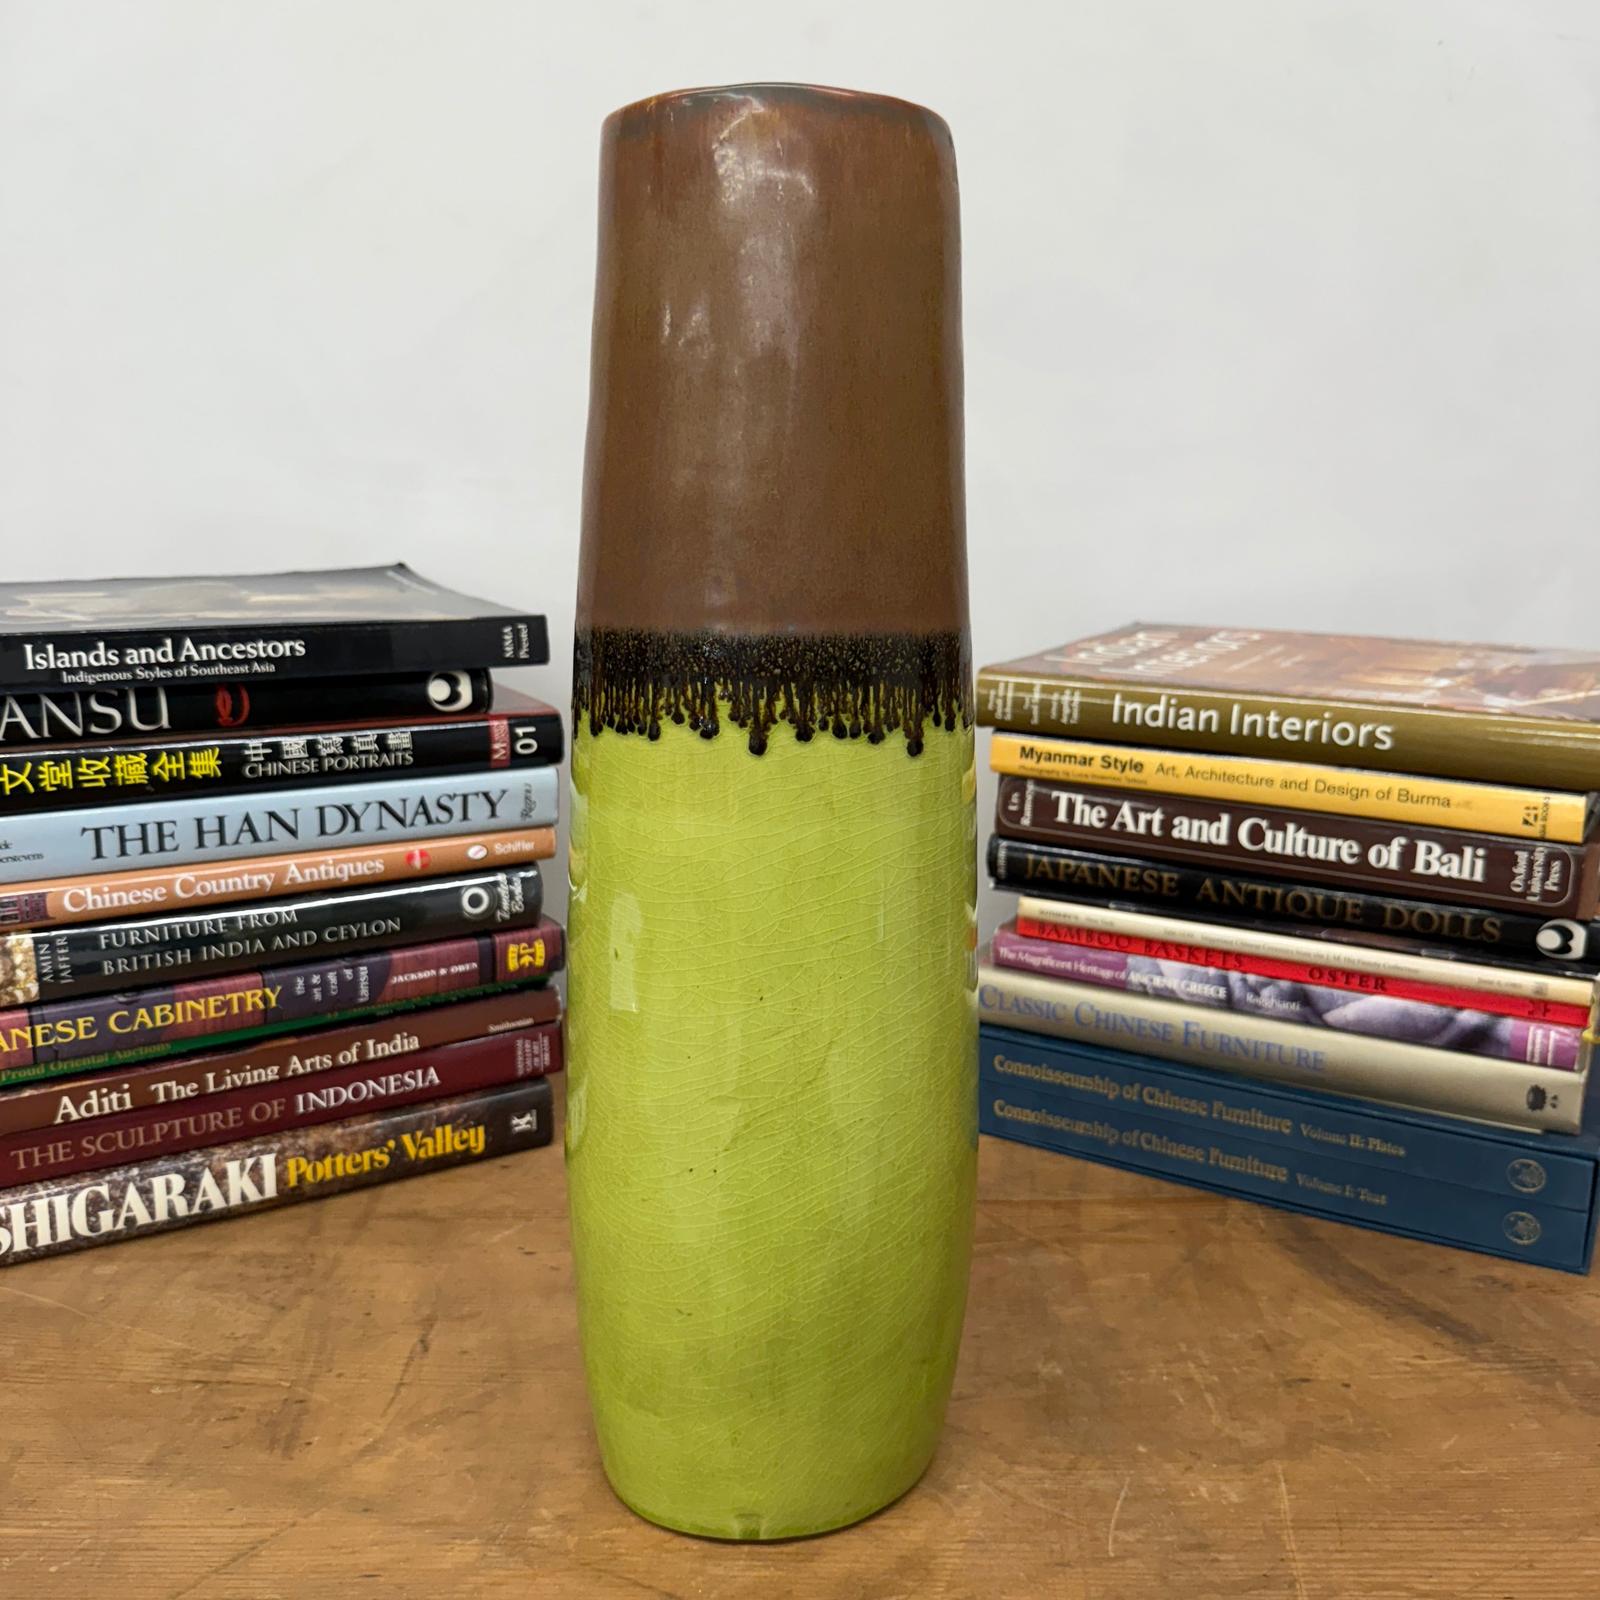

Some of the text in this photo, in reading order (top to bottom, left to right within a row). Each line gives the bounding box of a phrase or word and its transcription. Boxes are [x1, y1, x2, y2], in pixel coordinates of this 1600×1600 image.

[24, 637, 306, 671] Islands and Ancestors
[501, 625, 515, 658] MMA
[516, 623, 530, 659] Prestel
[62, 662, 276, 685] Indigenous Styles of Southeast Asia
[514, 726, 538, 755] 01
[1112, 691, 1220, 734] Indian
[1230, 703, 1395, 751] Interiors
[242, 750, 414, 779] CHINESE PORTRAITS
[1019, 745, 1096, 768] Myanmar
[1100, 754, 1145, 774] Style
[1155, 763, 1178, 779] Art,
[1184, 765, 1275, 788] Architecture
[1279, 776, 1309, 792] and
[1314, 778, 1370, 800] Design
[1375, 782, 1392, 800] of
[1397, 788, 1452, 809] Burma
[81, 789, 508, 861] THE HAN DYNASTY
[1051, 790, 1488, 884] The Art and Culture of Bali
[494, 840, 536, 855] Schiffer
[63, 858, 385, 913] Chinese Country Antiques
[1510, 849, 1529, 893] Oxford
[1527, 846, 1548, 902] University
[1544, 859, 1563, 892] Press
[511, 876, 525, 914] Books
[1023, 852, 1181, 898] JAPANESE
[1198, 878, 1363, 922] ANTIQUE
[1383, 903, 1500, 943] DOLLS
[99, 909, 298, 950] FURNITURE FROM
[103, 917, 401, 977] BRITISH INDIA AND CEYLON
[38, 943, 55, 982] AMIN
[55, 936, 75, 985] JAFFER
[343, 968, 354, 981] of
[392, 969, 437, 984] JACKSON
[998, 946, 1018, 961] The
[1019, 950, 1073, 973] Magnificent
[1073, 959, 1114, 981] Heritage
[1115, 969, 1126, 980] of
[1127, 971, 1184, 992] ANCIENT
[1184, 978, 1229, 1001] GREECE
[1037, 922, 1130, 949] BAMBOO
[1142, 938, 1244, 968] BASKETS
[1307, 966, 1389, 992] OSTER
[294, 976, 306, 997] the
[311, 974, 323, 1002] art &
[328, 971, 339, 997] craft
[357, 966, 370, 1004] tansu
[108, 985, 283, 1034] CABINETRY
[978, 983, 1327, 1072] CLASSIC CHINESE FURNITURE
[1, 1043, 172, 1081] Proud Oriental Auctions
[54, 1032, 421, 1125] Aditi The Living Arts of India
[10, 1066, 442, 1170] THE SCULPTURE OF INDONESIA
[993, 1054, 1121, 1100] Connoisseurship
[1122, 1082, 1142, 1100] of
[1142, 1086, 1208, 1117] Chinese
[1212, 1101, 1293, 1135] Furniture
[1300, 1123, 1346, 1146] Volume
[1367, 1137, 1406, 1158] Plates
[401, 1124, 487, 1161] Valley
[993, 1099, 1120, 1145] Connoisseurship
[1121, 1129, 1141, 1147] of
[1140, 1132, 1205, 1162] Chinese
[1208, 1147, 1288, 1182] Furniture
[1296, 1172, 1342, 1196] Volume
